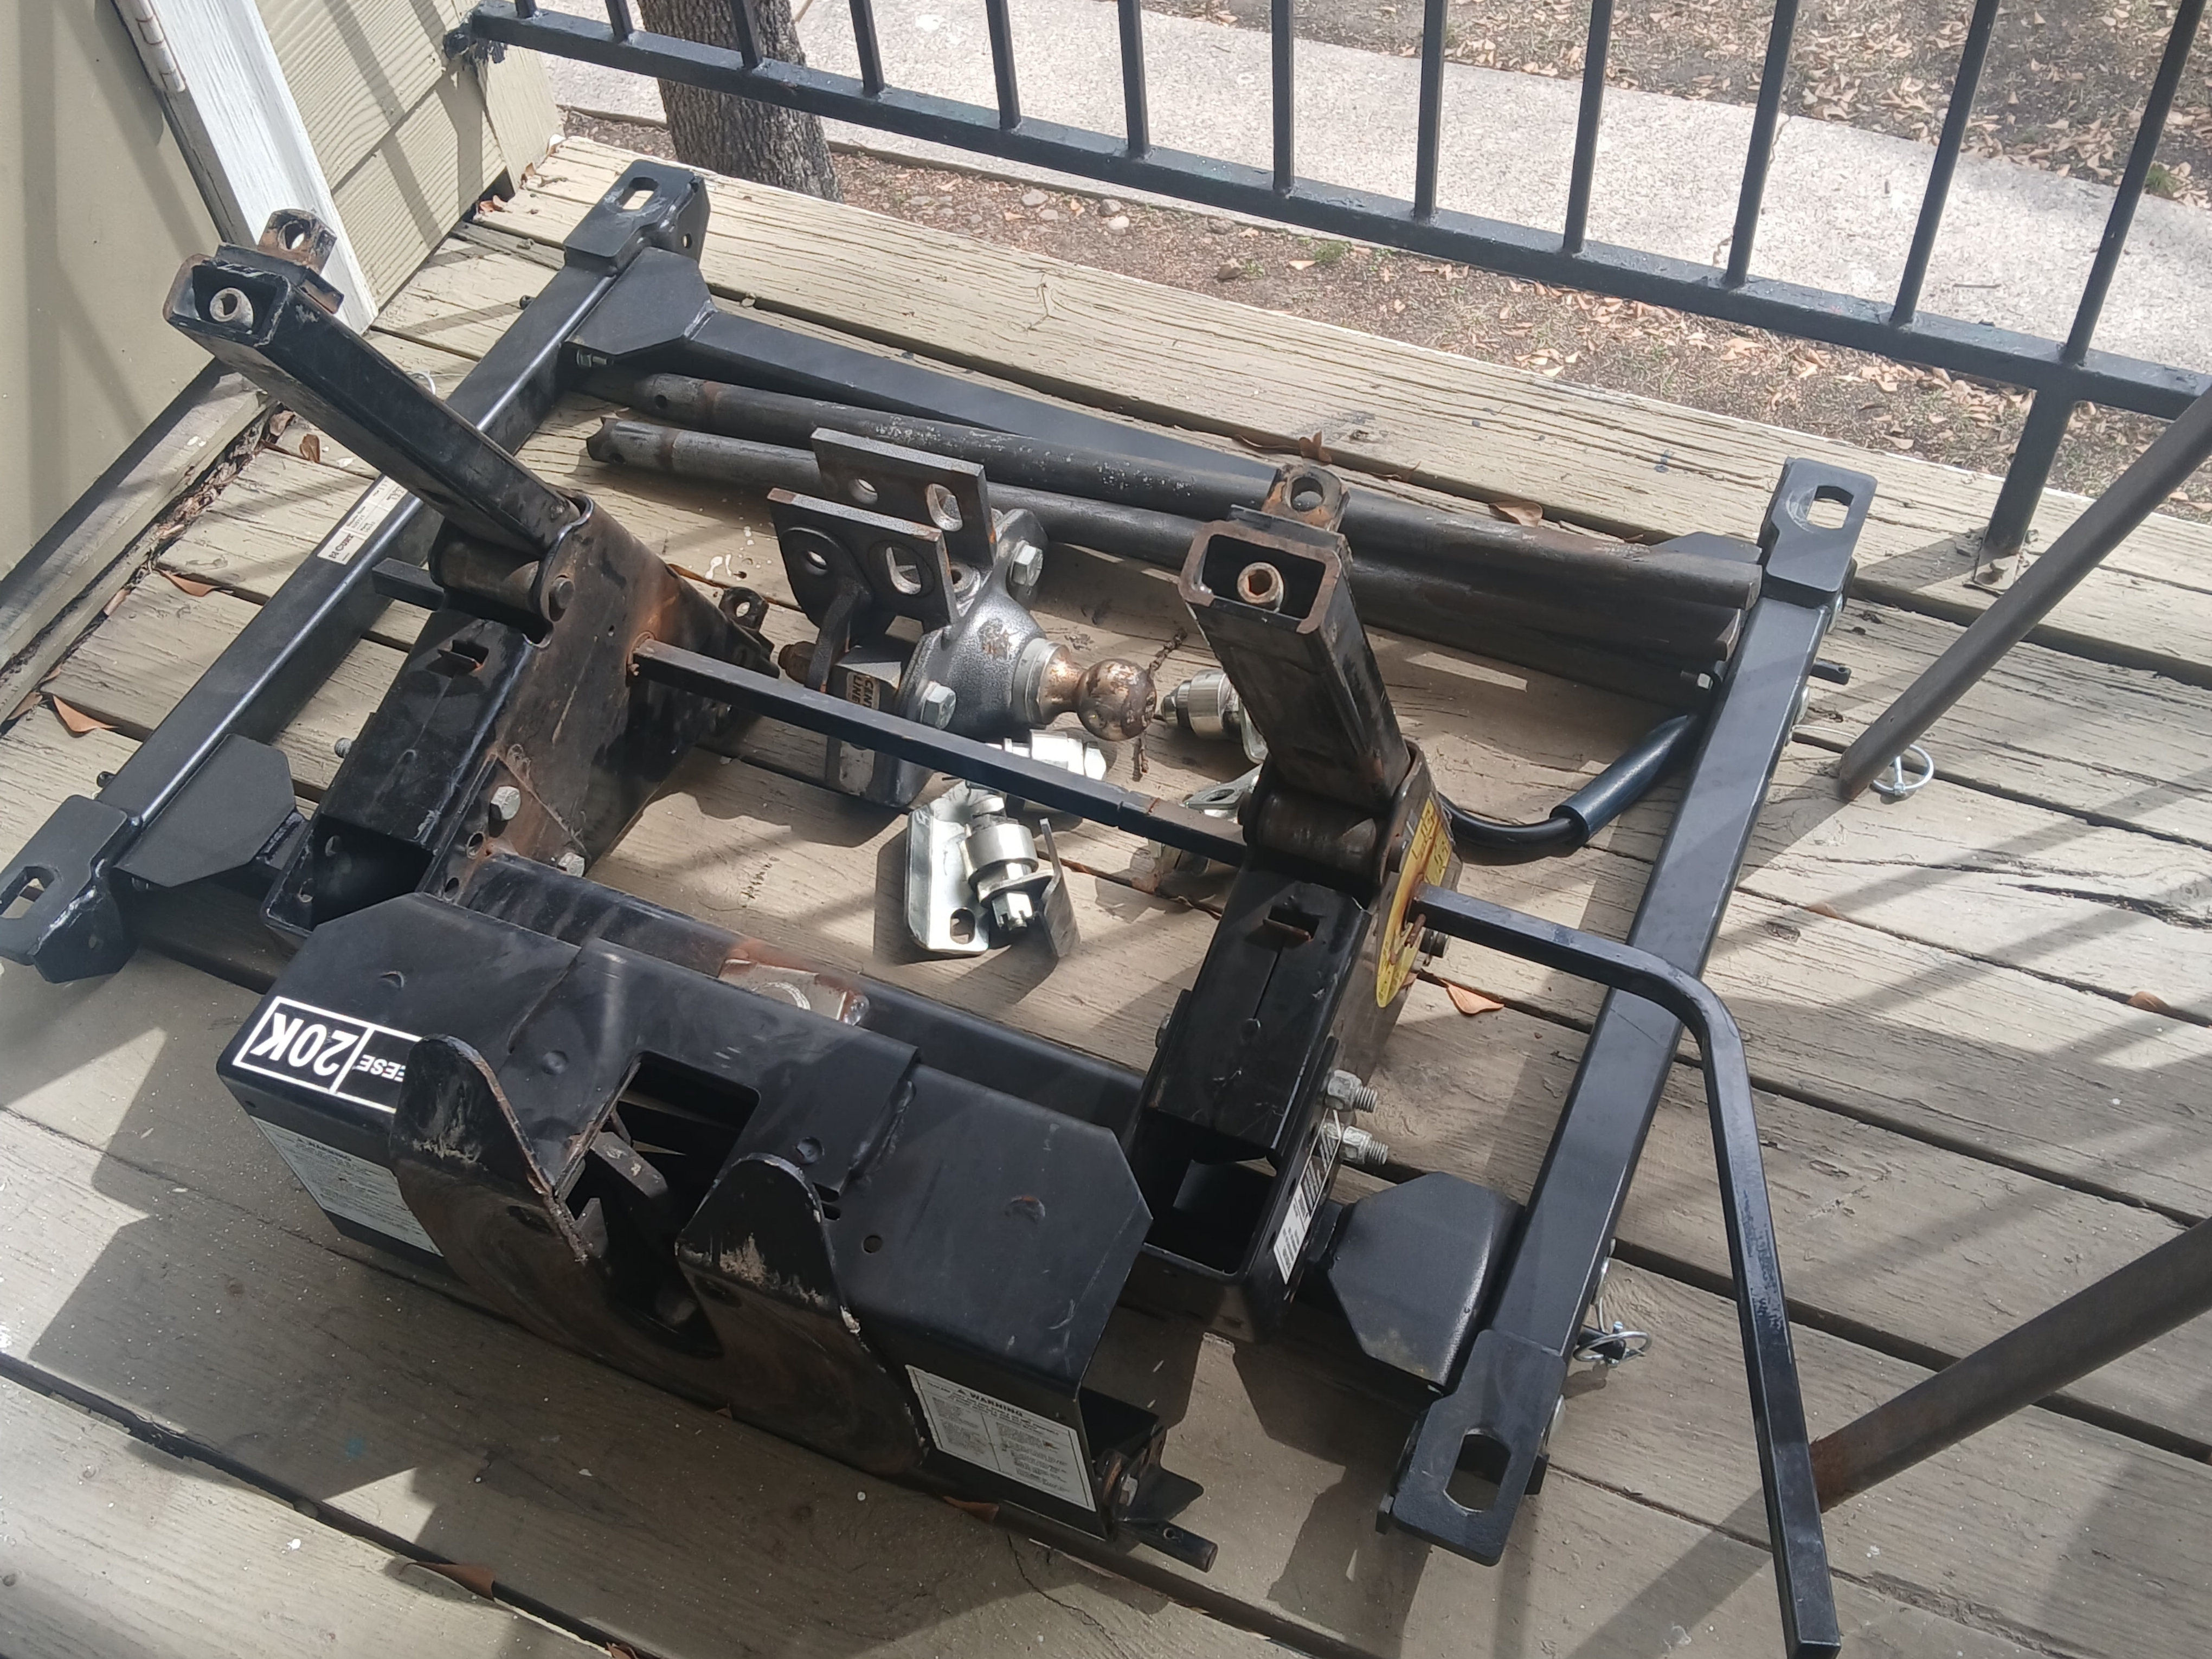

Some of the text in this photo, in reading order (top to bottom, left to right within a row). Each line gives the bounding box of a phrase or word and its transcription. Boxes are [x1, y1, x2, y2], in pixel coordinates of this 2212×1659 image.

[864, 680, 873, 709] CENT
[249, 1012, 406, 1082] EESE 20K
